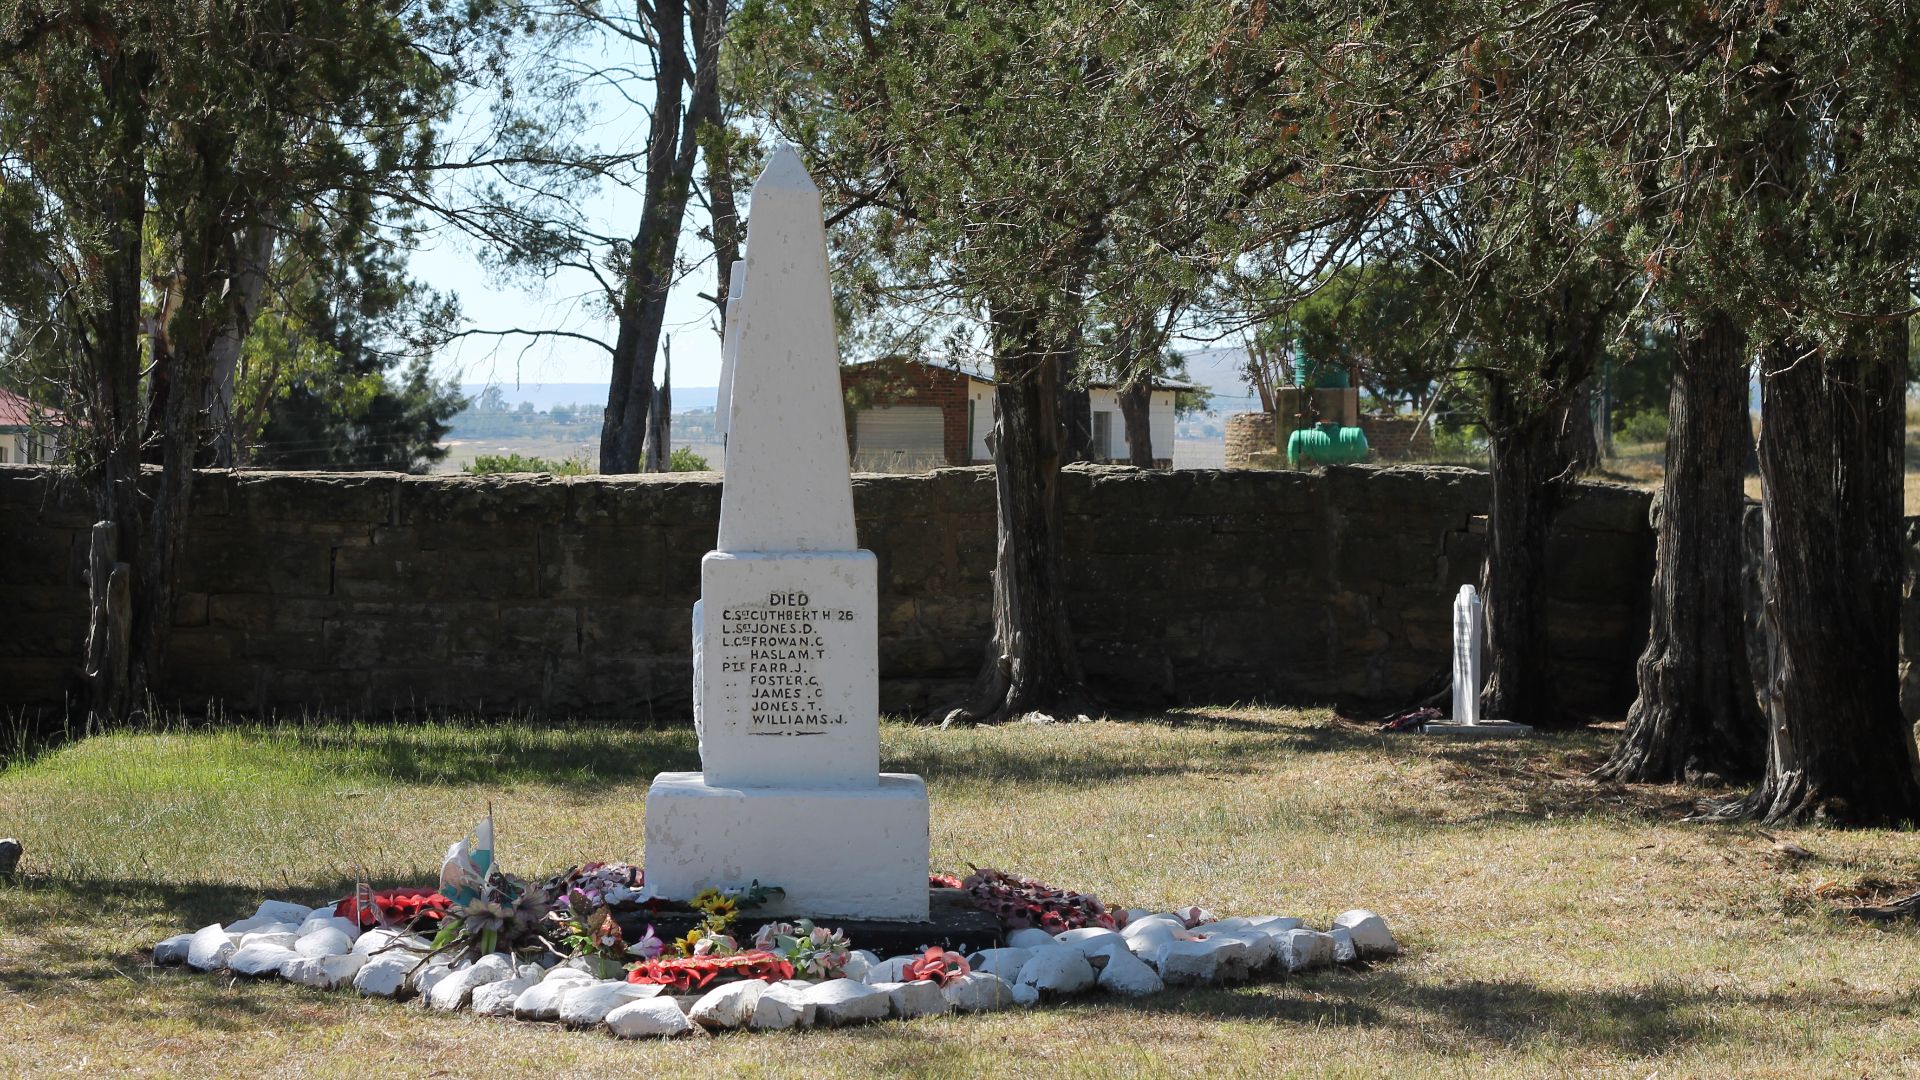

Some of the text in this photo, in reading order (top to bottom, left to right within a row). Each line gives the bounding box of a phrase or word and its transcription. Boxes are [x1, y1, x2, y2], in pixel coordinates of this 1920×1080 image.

[770, 593, 809, 606] DIED
[750, 610, 818, 620] CUTHBERT
[822, 610, 831, 620] H
[838, 610, 854, 621] 26
